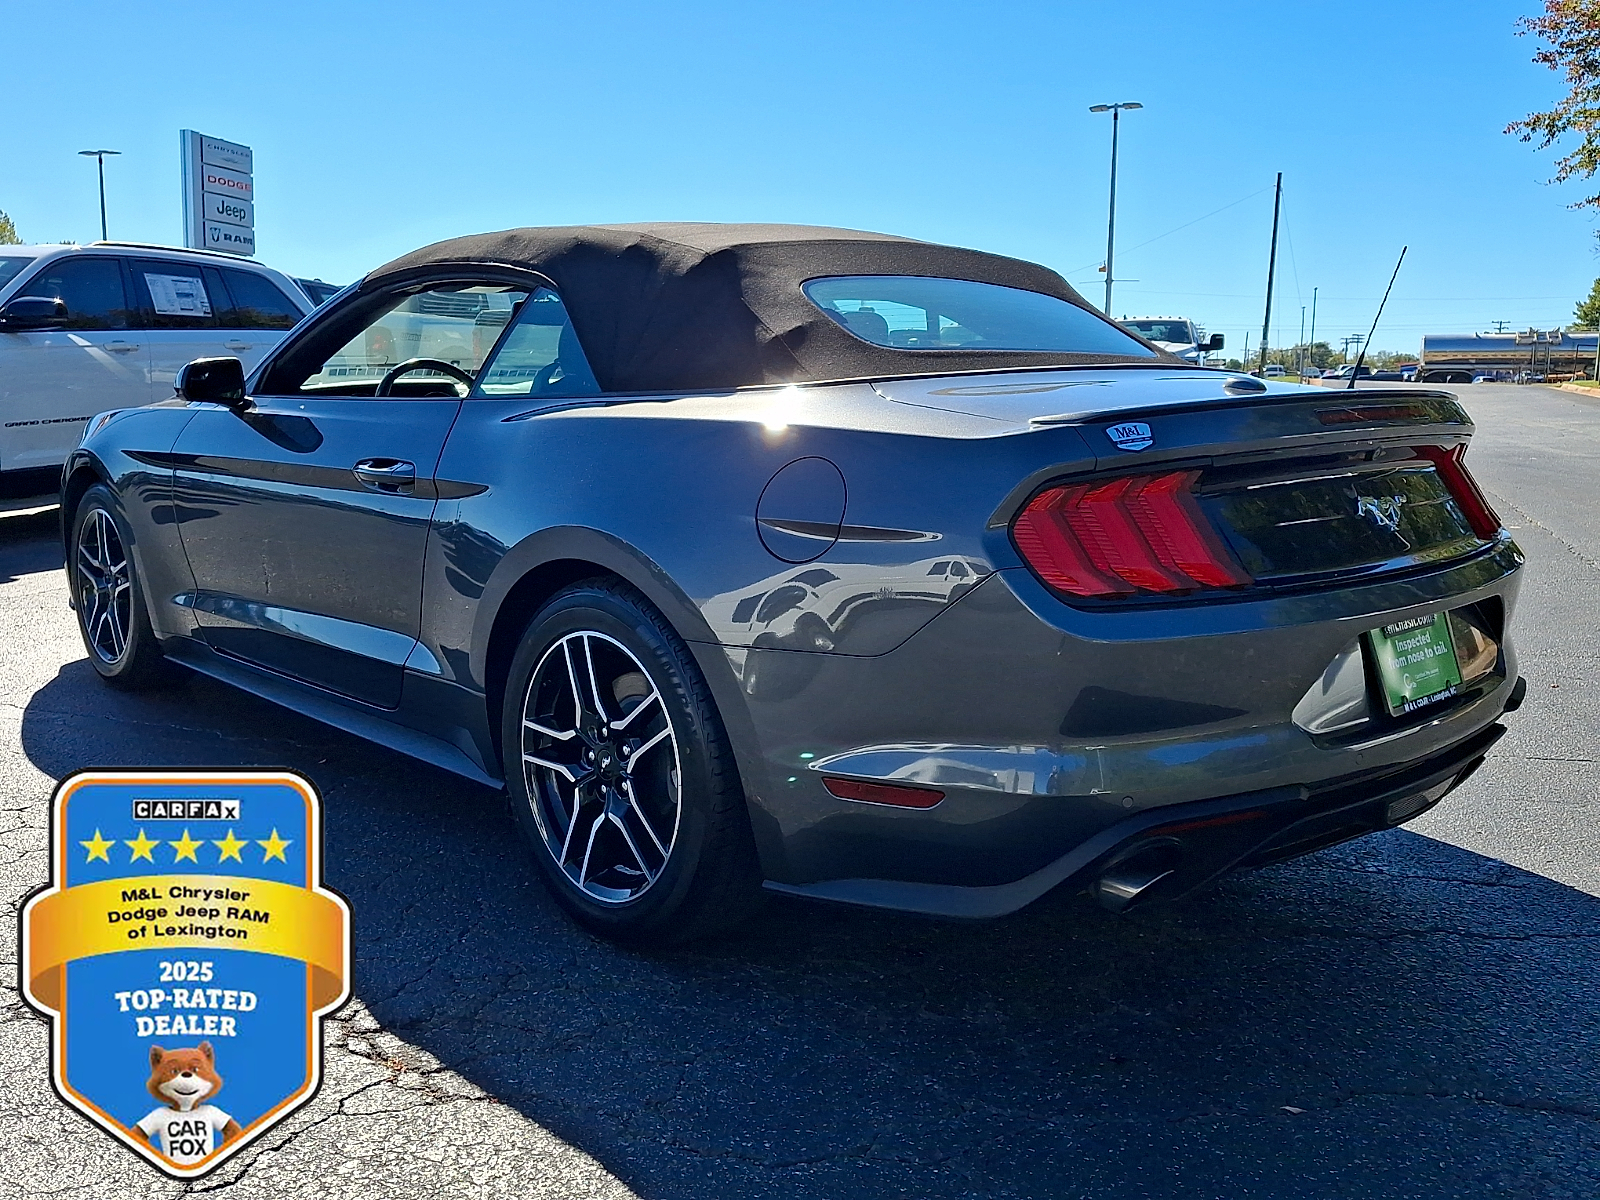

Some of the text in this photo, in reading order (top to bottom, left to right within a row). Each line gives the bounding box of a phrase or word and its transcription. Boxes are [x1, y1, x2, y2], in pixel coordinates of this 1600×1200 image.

[207, 143, 250, 158] CHRYSLER
[207, 175, 252, 192] DODGE
[216, 200, 246, 221] Jeep
[223, 233, 253, 245] RAM
[4, 420, 40, 428] GRAND
[1114, 425, 1145, 438] M&L
[1395, 631, 1431, 652] Inspected
[1388, 641, 1448, 670] from nose to tail.
